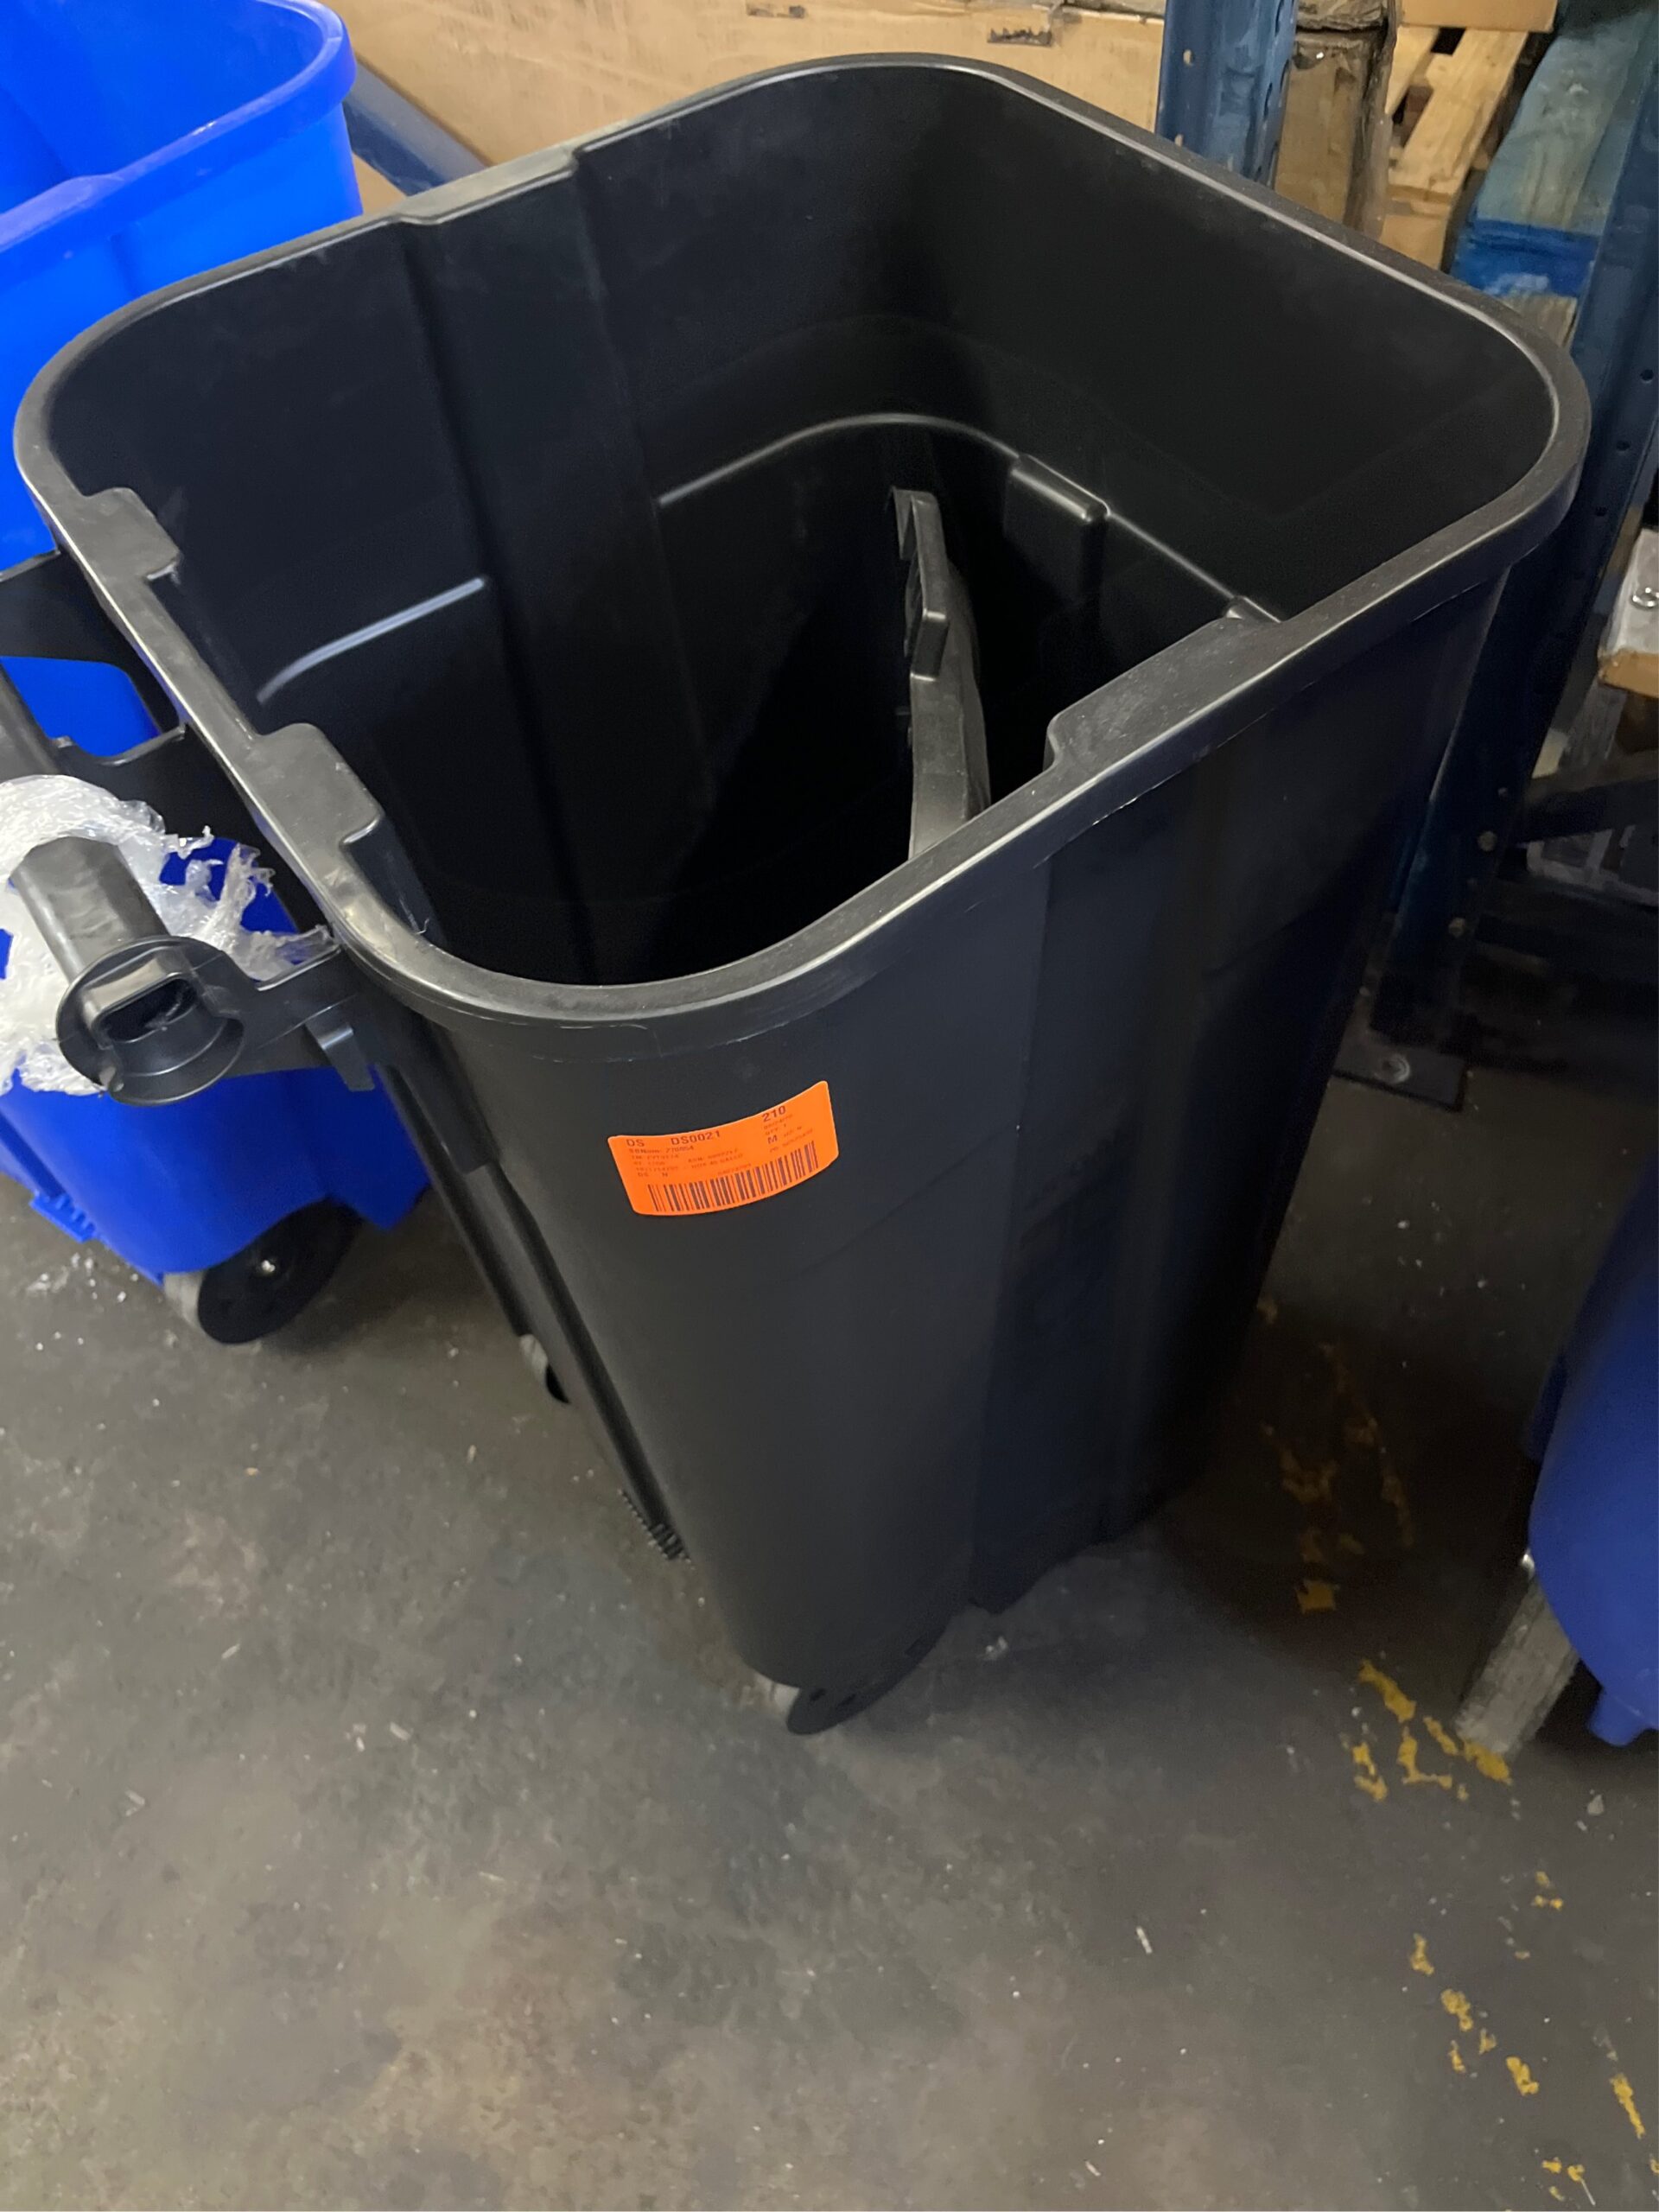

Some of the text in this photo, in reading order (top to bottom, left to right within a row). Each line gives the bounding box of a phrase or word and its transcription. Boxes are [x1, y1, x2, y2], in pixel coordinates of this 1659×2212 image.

[761, 1105, 786, 1122] 210
[671, 1130, 721, 1146] DS0021
[767, 1134, 779, 1145] M
